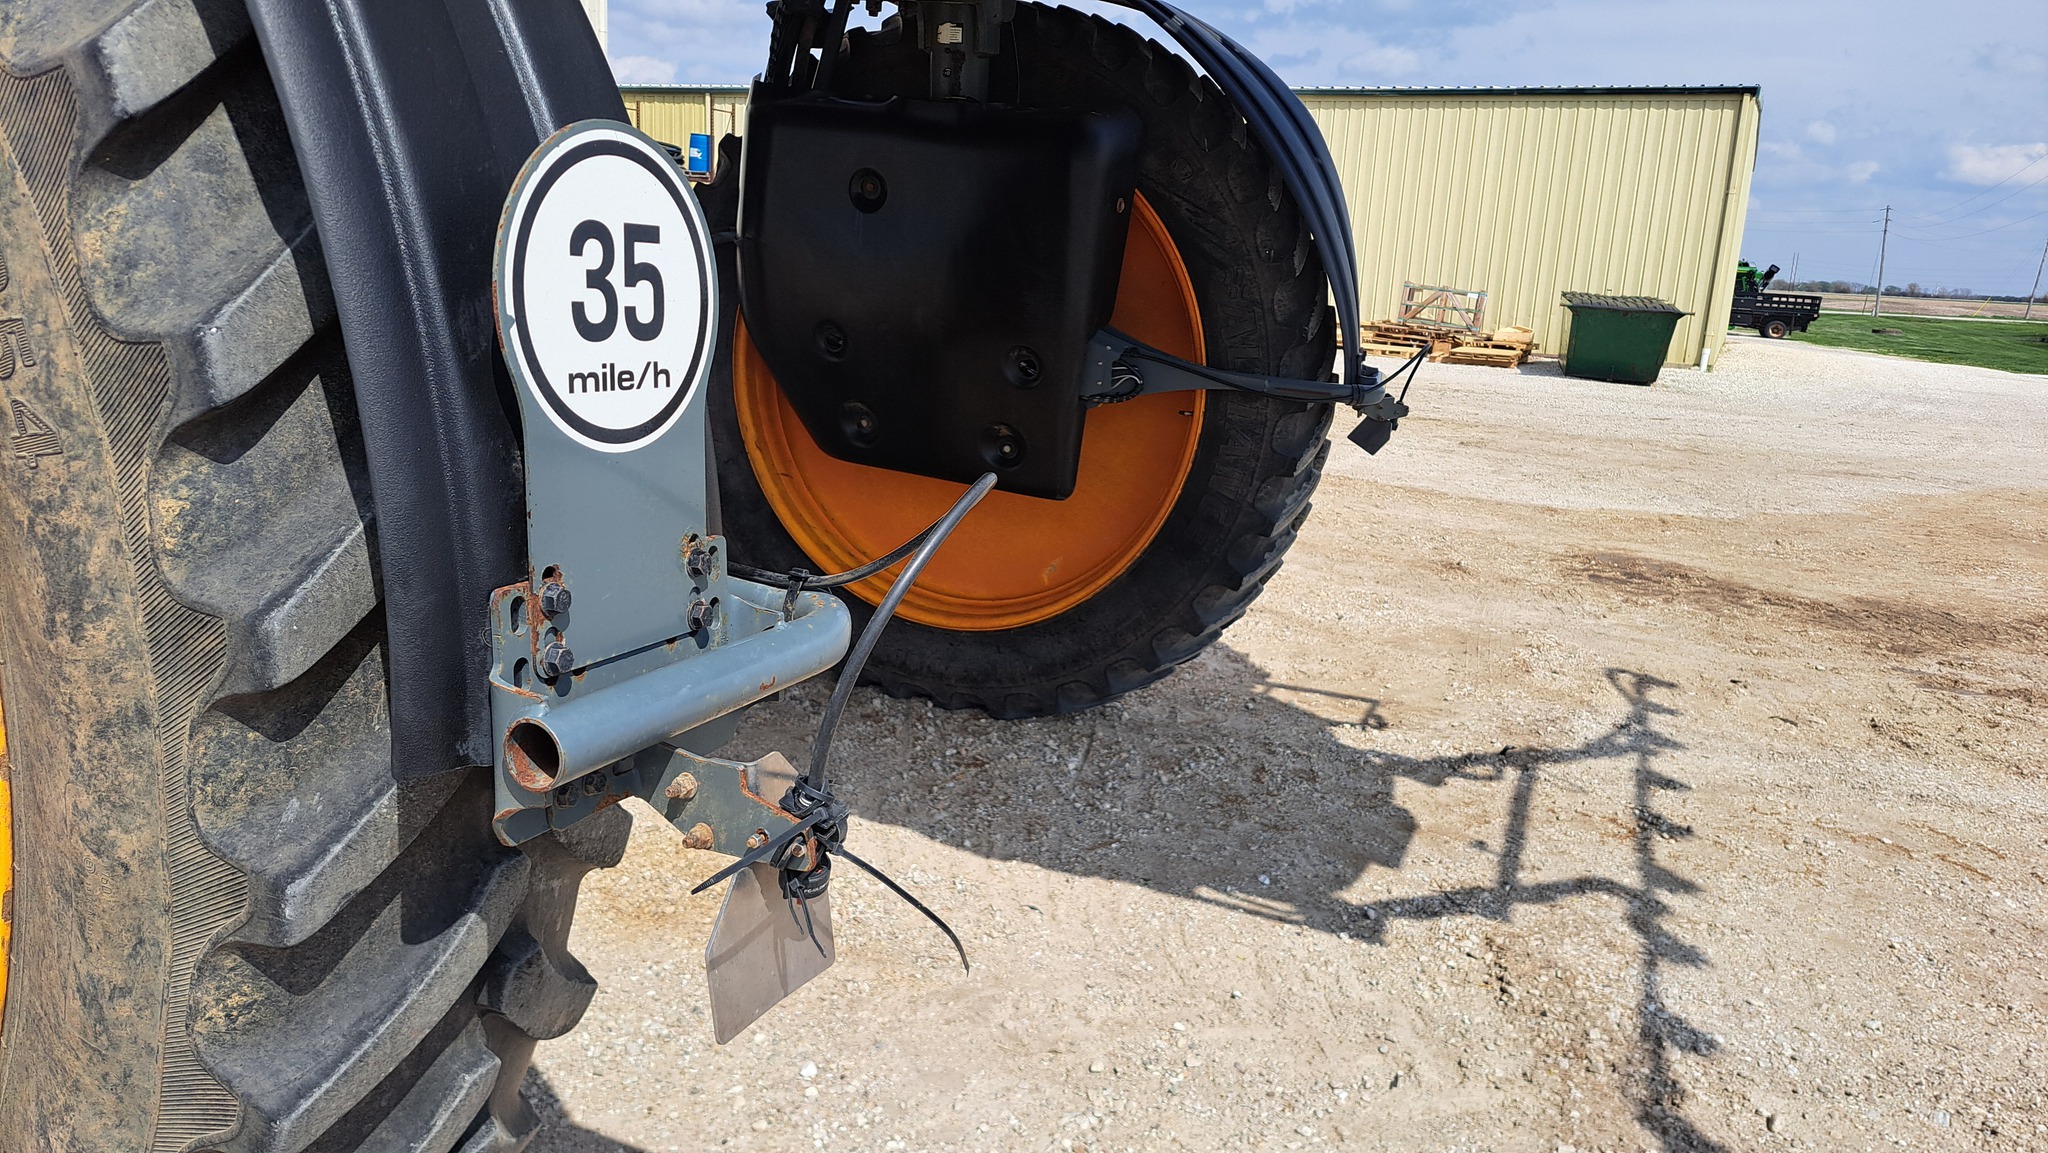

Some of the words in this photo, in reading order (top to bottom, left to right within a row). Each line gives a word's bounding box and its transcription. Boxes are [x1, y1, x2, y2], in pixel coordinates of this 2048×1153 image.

[0, 252, 63, 469] 54
[569, 219, 665, 342] 35
[568, 361, 671, 394] mile/h
[1185, 301, 1265, 550] ALIANCE
